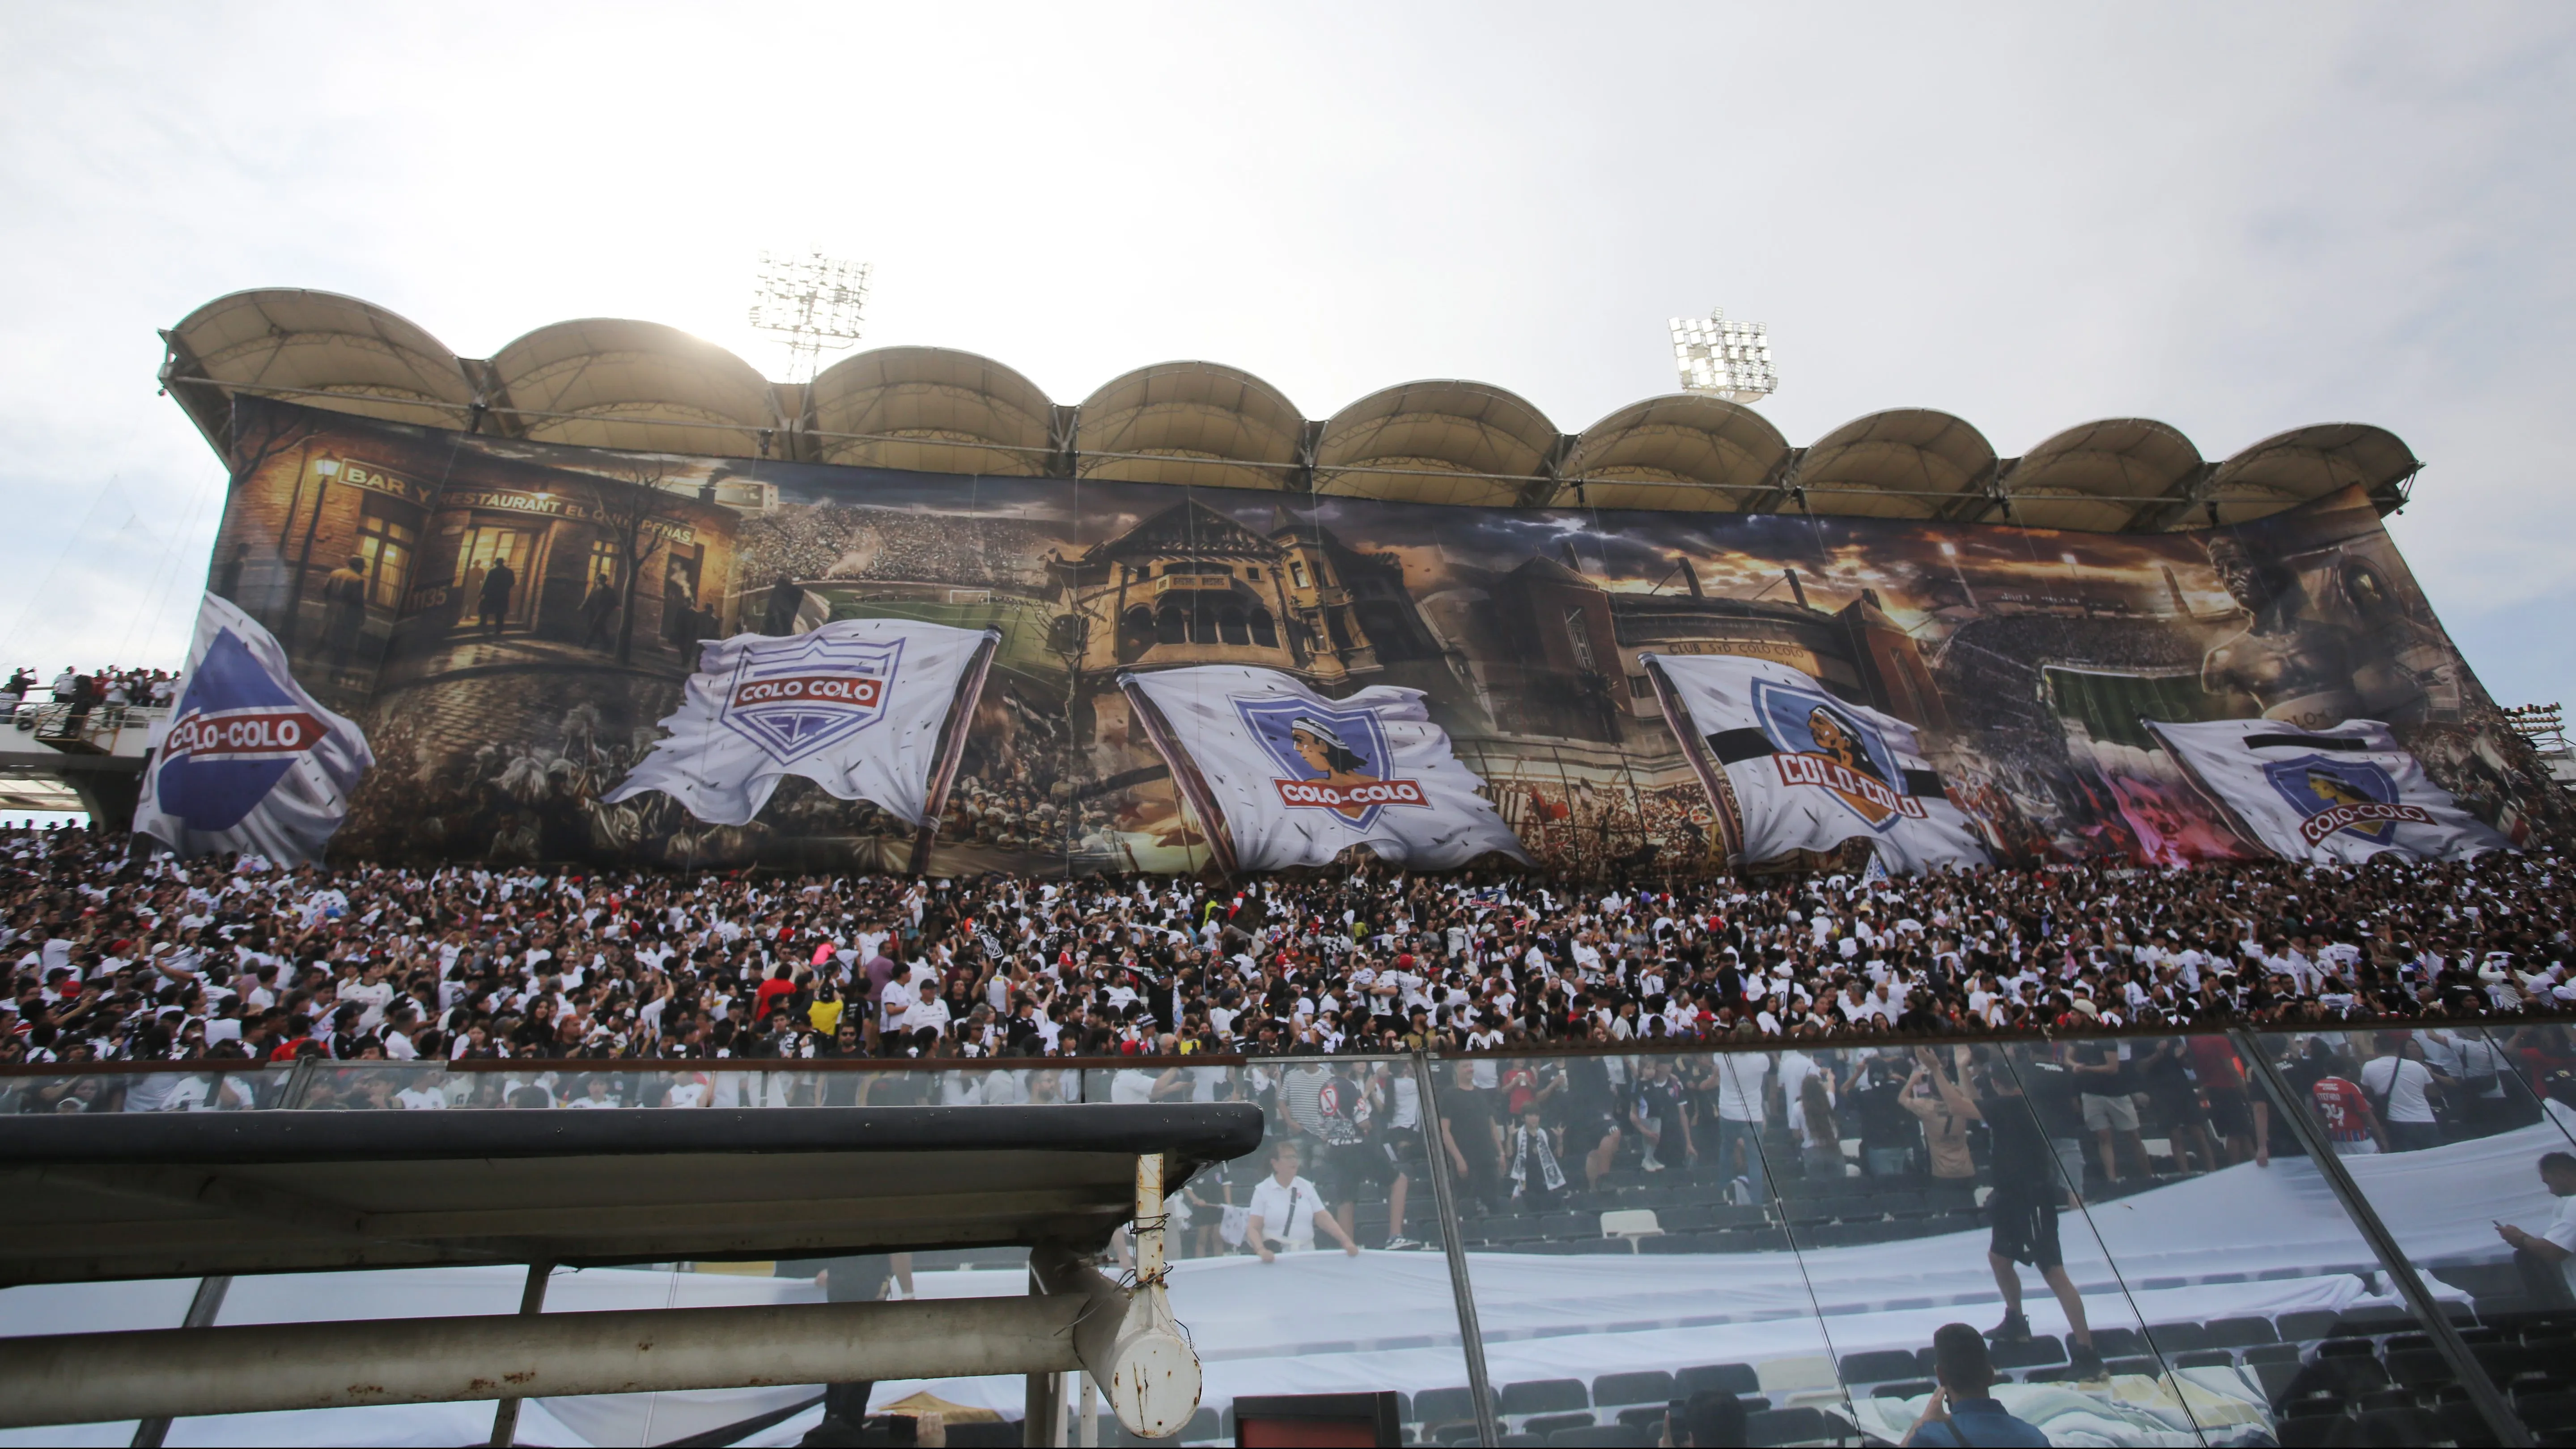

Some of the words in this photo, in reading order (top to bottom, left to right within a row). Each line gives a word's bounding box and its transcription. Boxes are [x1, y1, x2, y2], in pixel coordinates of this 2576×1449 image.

[347, 467, 406, 495] BAR
[415, 485, 433, 502] Y
[438, 492, 561, 513] RESTAURANT
[565, 505, 589, 518] EL
[1669, 643, 1701, 654] CLUB
[1739, 644, 1771, 654] COLO
[1774, 646, 1804, 658] COLO
[740, 680, 803, 701] COLO
[808, 680, 874, 701] COLO
[170, 719, 301, 750] COLO-COLO
[1282, 784, 1419, 805] COLO-COLO
[1778, 754, 1923, 818] COLO-COLO
[2305, 804, 2427, 840] COLO-COLO
